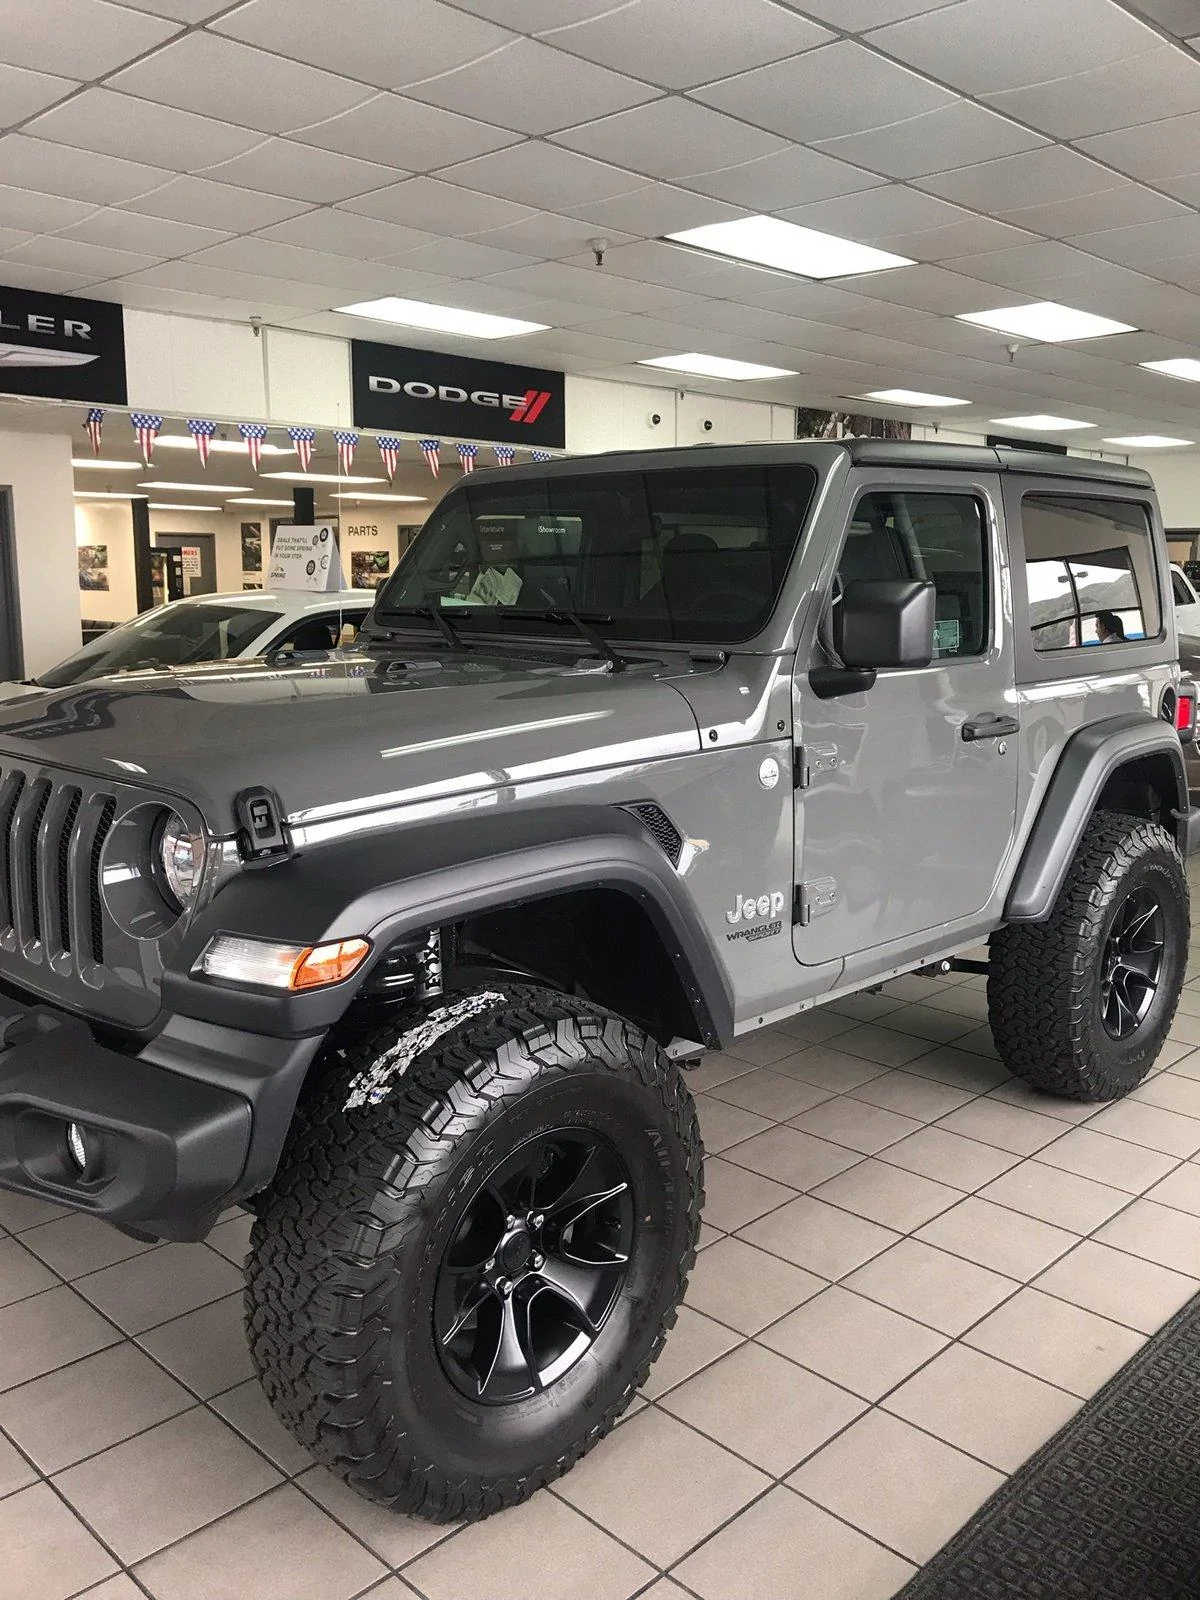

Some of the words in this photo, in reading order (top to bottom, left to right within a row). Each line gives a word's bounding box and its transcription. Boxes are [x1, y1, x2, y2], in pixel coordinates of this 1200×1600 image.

[368, 375, 527, 411] DODGE
[348, 525, 378, 536] PARTS
[726, 891, 784, 924] Jeep
[726, 920, 782, 941] WRANGLER
[421, 938, 442, 991] FOX
